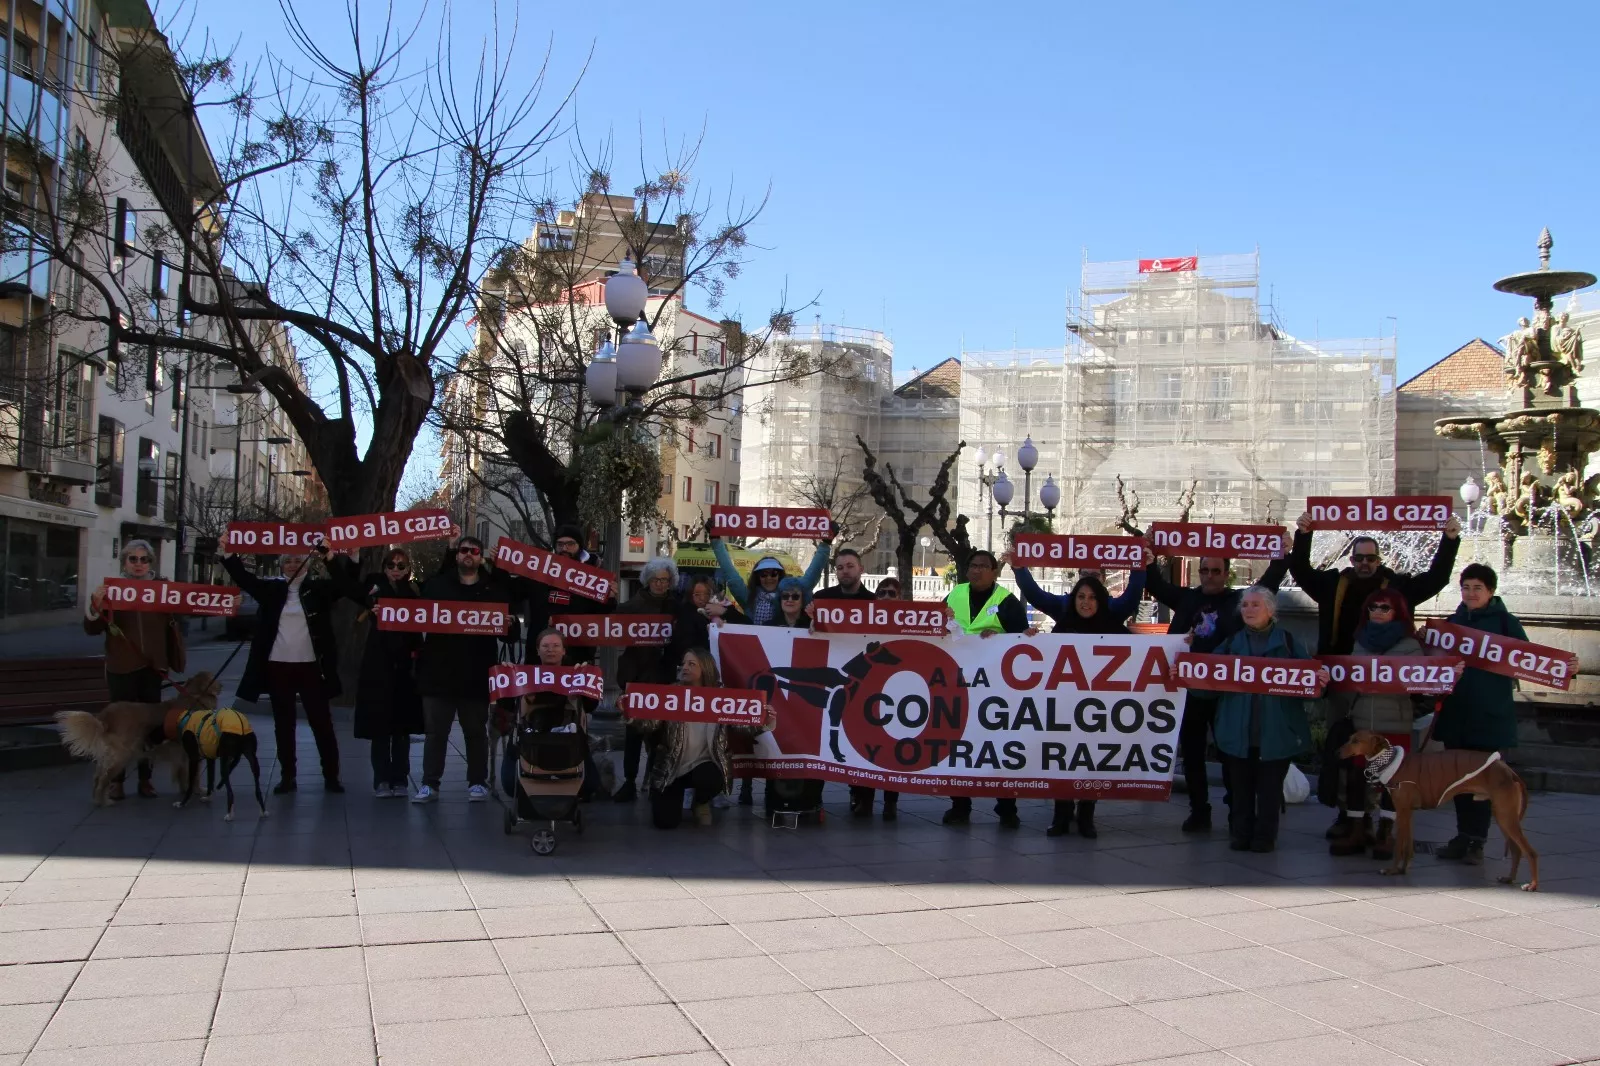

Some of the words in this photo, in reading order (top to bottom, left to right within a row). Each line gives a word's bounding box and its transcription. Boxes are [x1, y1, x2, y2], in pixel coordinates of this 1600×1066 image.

[714, 513, 740, 528] no
[745, 514, 758, 529] a
[762, 509, 780, 529] la
[785, 515, 830, 531] caza
[1311, 505, 1341, 521] no
[1346, 505, 1360, 521] a
[1366, 499, 1388, 521] la
[1393, 504, 1448, 521] caza
[230, 530, 257, 545] no
[261, 531, 274, 545] a
[279, 526, 298, 546] la
[302, 531, 325, 546] ca
[330, 524, 359, 541] no
[363, 523, 376, 538] a
[380, 516, 400, 536] la
[404, 515, 451, 533] caza
[1154, 530, 1182, 547] no
[1187, 531, 1200, 548] a
[1205, 526, 1225, 549] la
[1231, 533, 1281, 551] caza
[1017, 542, 1045, 558] no
[1049, 543, 1063, 559] a
[1068, 537, 1088, 559] la
[1093, 544, 1142, 560] caza
[497, 545, 524, 565] no
[526, 555, 540, 571] a
[542, 554, 562, 578] la
[565, 568, 609, 594] caza
[107, 585, 137, 602] no
[141, 588, 155, 603] a
[160, 584, 181, 604] la
[186, 591, 234, 608] caza
[381, 606, 409, 623] no
[414, 608, 427, 623] a
[432, 602, 452, 624] la
[457, 609, 504, 626] caza
[816, 607, 845, 624] no
[849, 608, 863, 624] a
[868, 602, 888, 625] la
[893, 609, 943, 627] caza
[587, 622, 599, 638] a
[604, 617, 623, 638] la
[627, 622, 673, 638] caza
[1425, 628, 1455, 650] no
[1458, 636, 1475, 655] a
[1478, 634, 1502, 662] la
[1508, 649, 1567, 679] caza
[488, 673, 510, 692] no
[515, 671, 528, 686] a
[534, 667, 555, 684] la
[928, 667, 947, 687] A
[956, 667, 991, 688] LA
[1001, 643, 1178, 693] CAZA
[1179, 661, 1208, 679] no
[1213, 663, 1228, 681] a
[1233, 658, 1255, 683] la
[1261, 666, 1316, 686] caza
[1350, 665, 1365, 683] a
[1371, 659, 1393, 683] la
[1398, 665, 1455, 683] caza
[629, 692, 660, 709] no
[664, 694, 678, 711] a
[684, 689, 705, 713] la
[710, 697, 762, 715] caza
[718, 632, 969, 772] NO
[863, 692, 961, 729] CON
[978, 696, 1176, 734] GALGOS
[865, 744, 882, 763] Y
[894, 737, 1027, 771] OTRAS
[1042, 741, 1174, 773] RAZAS
[765, 761, 804, 770] indefensa
[806, 762, 826, 771] está
[828, 765, 846, 774] una
[848, 769, 886, 782] criatura,
[888, 775, 908, 784] más
[910, 777, 948, 786] derecho
[950, 778, 974, 787] tiene
[984, 780, 1000, 788] ser
[1002, 780, 1050, 789] defendida
